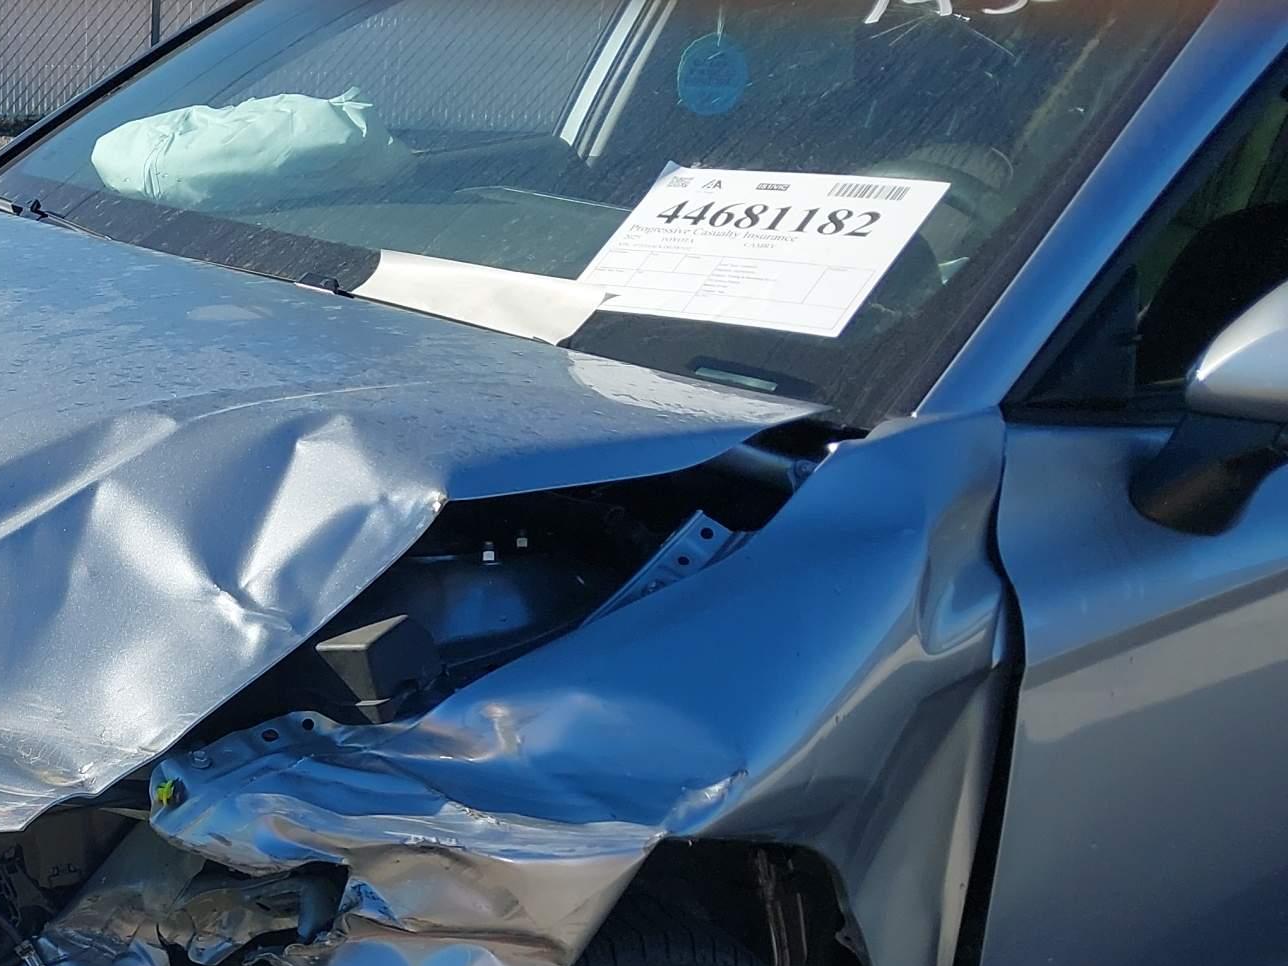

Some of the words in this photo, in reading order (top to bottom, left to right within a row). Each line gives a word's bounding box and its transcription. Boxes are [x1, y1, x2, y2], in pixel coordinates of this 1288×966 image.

[629, 223, 691, 236] Progressive
[692, 227, 739, 240] Casualty
[743, 231, 799, 243] Insurance
[656, 199, 881, 238] 44681182
